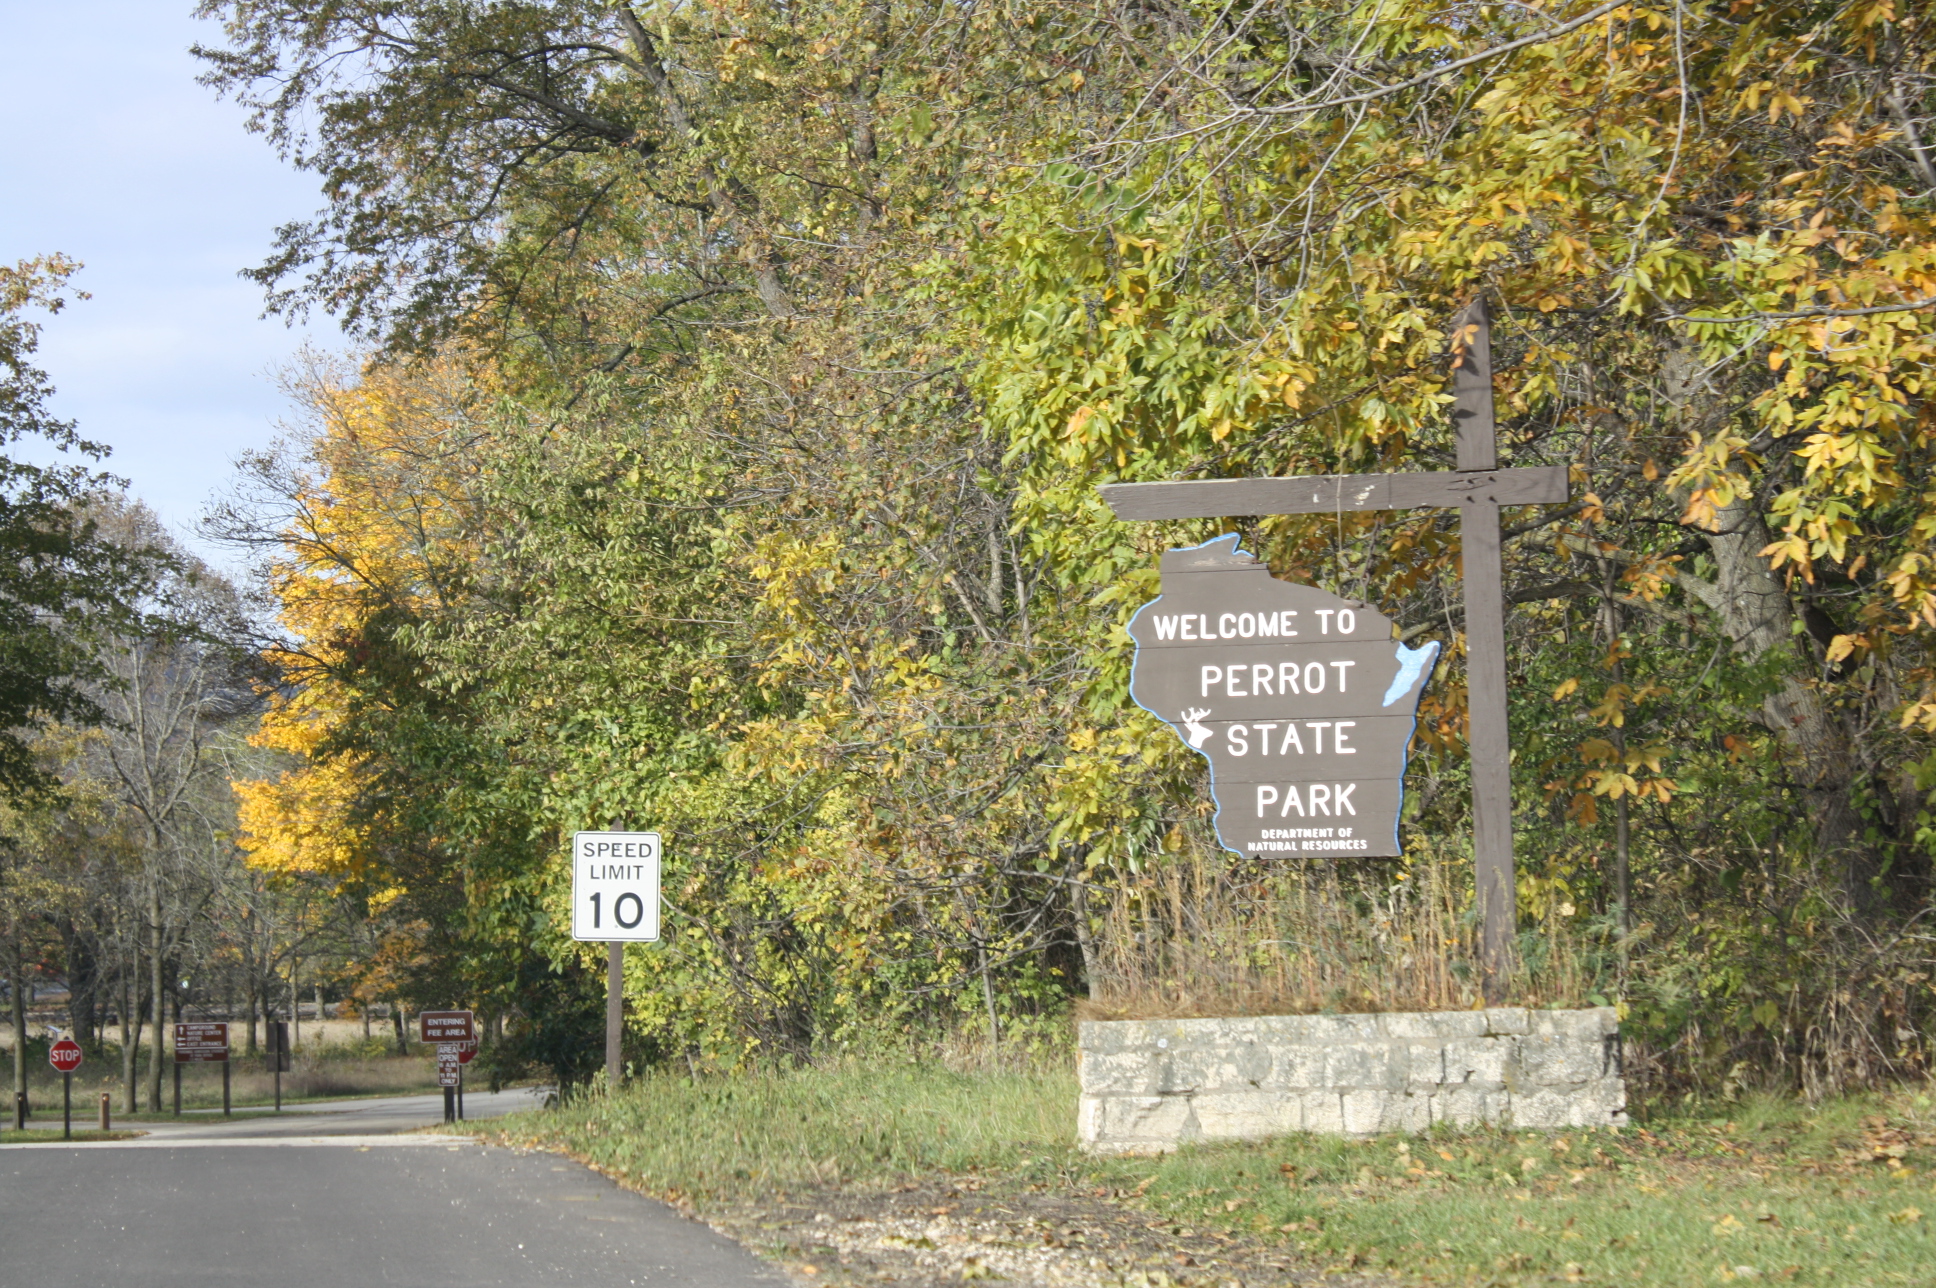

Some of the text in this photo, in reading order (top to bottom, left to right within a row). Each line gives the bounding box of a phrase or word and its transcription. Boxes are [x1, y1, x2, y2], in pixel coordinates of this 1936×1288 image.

[1153, 609, 1356, 640] WELCOME TO
[1201, 661, 1356, 698] PERROT
[1227, 722, 1356, 757] STATE
[1256, 784, 1357, 818] PARK
[1261, 827, 1353, 840] DEPARTMENT OF
[583, 842, 652, 858] SPEED
[1247, 839, 1368, 852] NATURAL RESOURCES
[590, 864, 644, 880] LIMIT
[589, 891, 644, 930] 10
[51, 1050, 79, 1062] STOP
